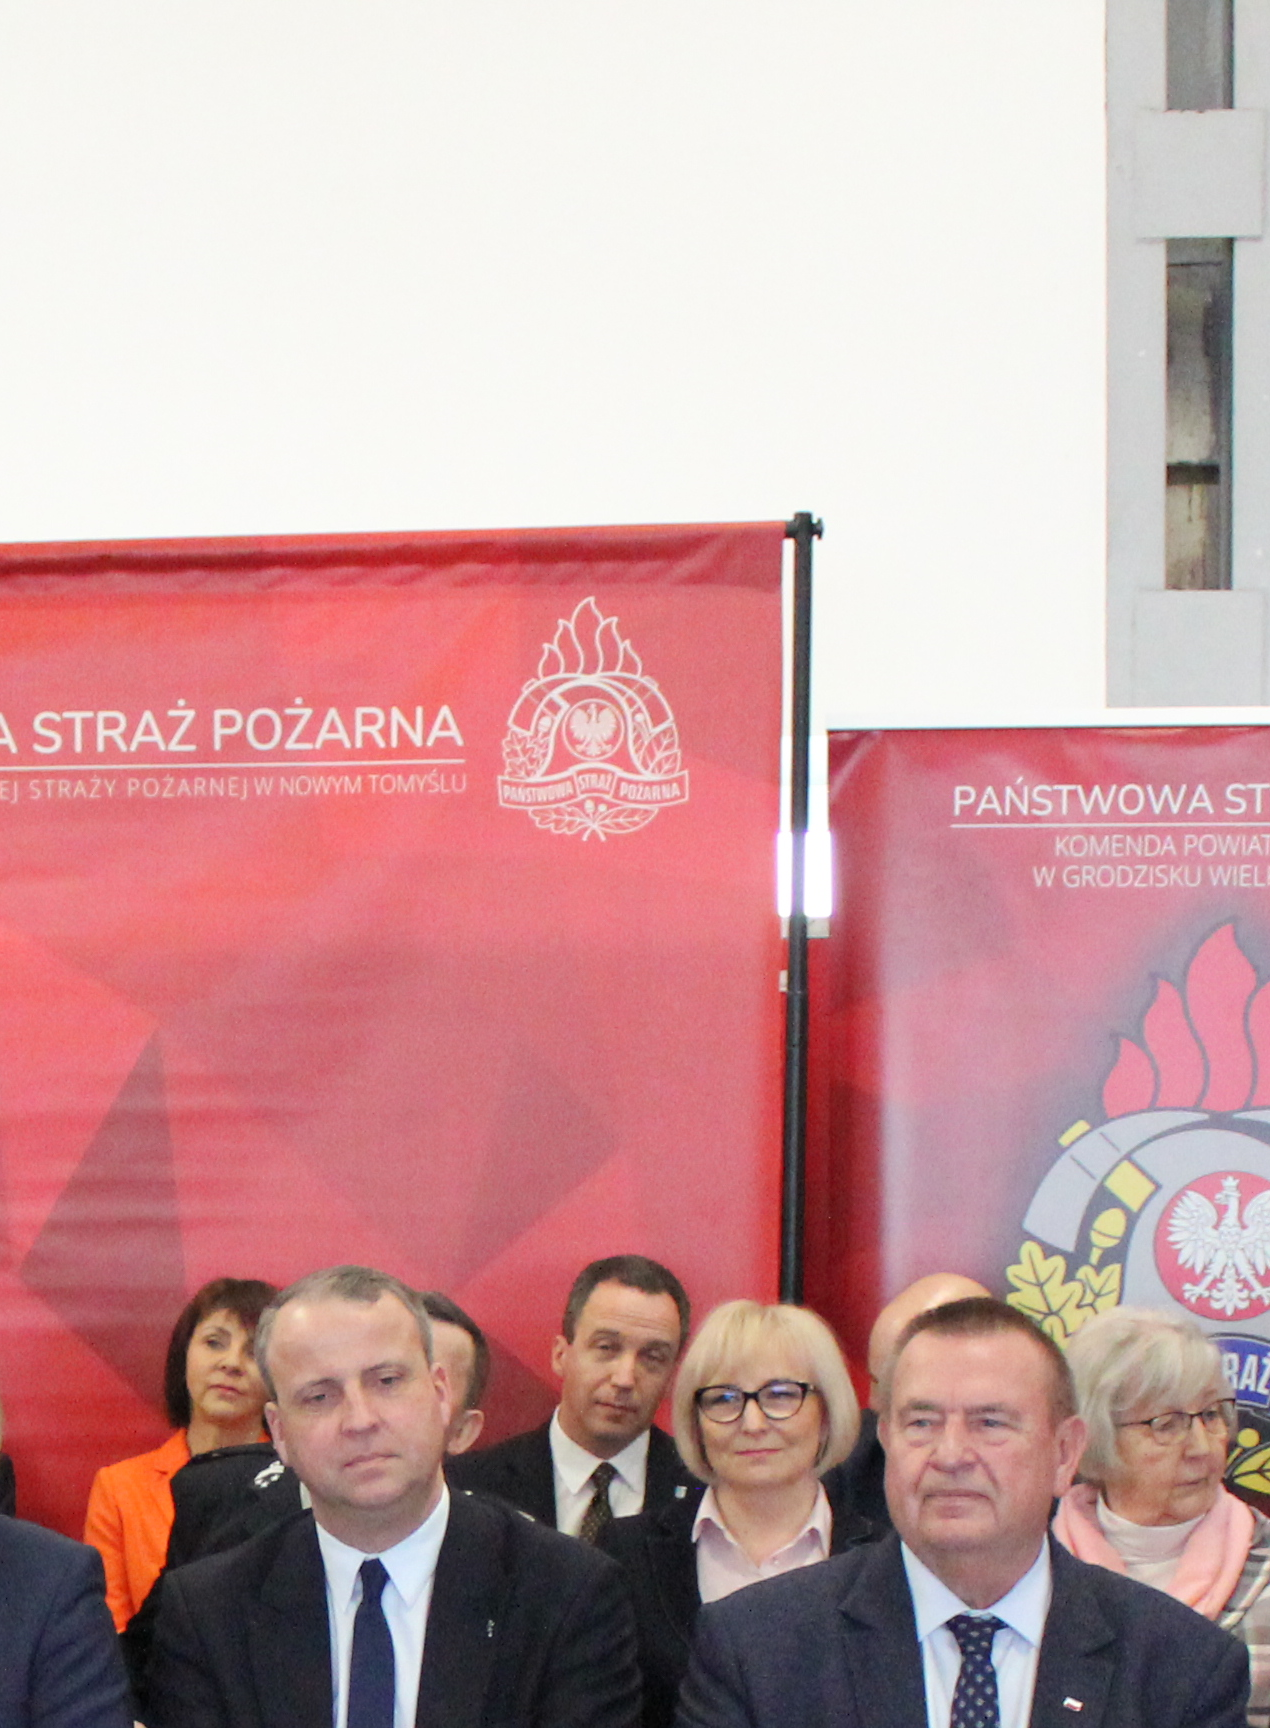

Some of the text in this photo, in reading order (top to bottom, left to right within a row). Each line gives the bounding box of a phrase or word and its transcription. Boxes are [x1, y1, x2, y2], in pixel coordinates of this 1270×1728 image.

[32, 698, 197, 755] STRAŻ
[213, 696, 465, 752] POŻARNA
[29, 773, 116, 800] STRAŻY
[127, 773, 249, 801] POŻARNEJ
[253, 776, 274, 797] W
[279, 774, 362, 796] NOWYM
[368, 768, 468, 794] TOMYŚLU
[578, 773, 613, 791] STRAŻ
[619, 780, 681, 800] POŻARNA
[953, 775, 1215, 817] PAŃSTWOWA
[1055, 834, 1177, 857] KOMENDA
[1032, 865, 1270, 888] W GRODZISKU WIEL
